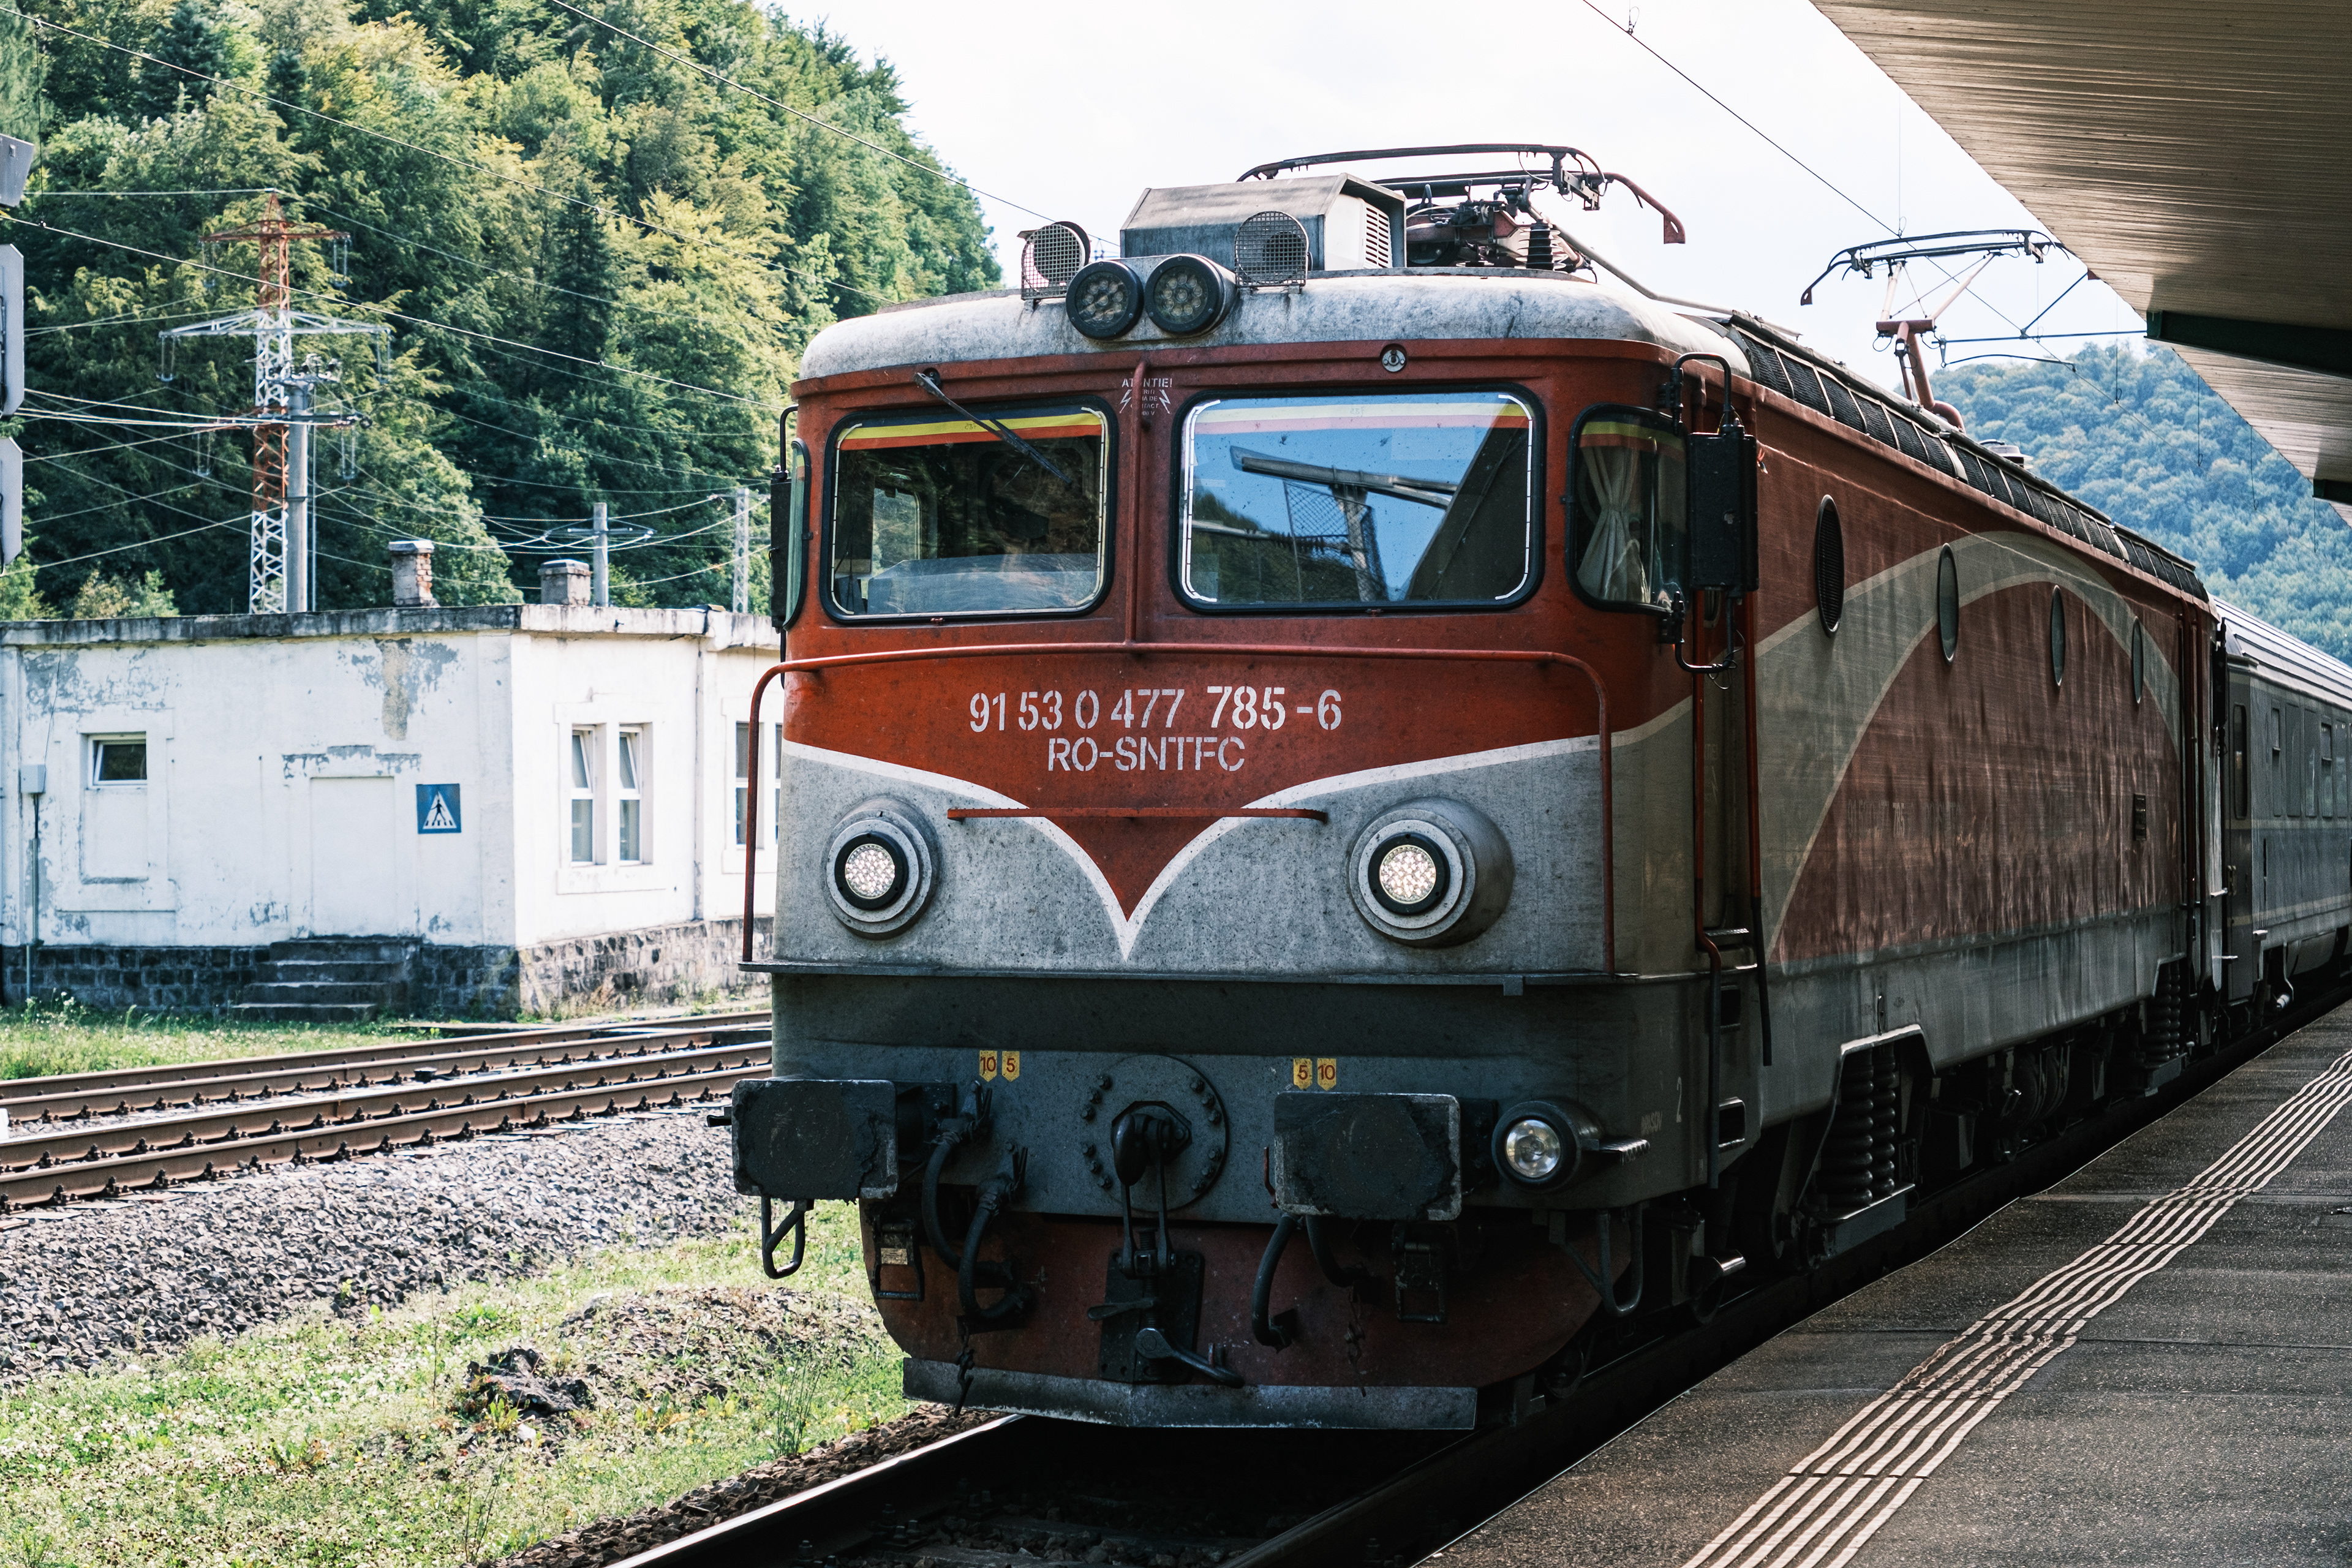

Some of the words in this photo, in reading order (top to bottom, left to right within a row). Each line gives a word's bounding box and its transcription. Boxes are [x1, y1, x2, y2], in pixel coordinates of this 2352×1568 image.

[1121, 378, 1172, 387] ATNTIE!
[970, 692, 1005, 731] 91
[1019, 690, 1063, 731] 53
[1075, 690, 1099, 729] 0
[1110, 689, 1185, 728] 477
[1048, 736, 1245, 772] RO-SNTFC
[981, 1057, 996, 1072] 10
[1006, 1058, 1016, 1073] 5
[1298, 1065, 1308, 1080] 5
[1317, 1065, 1335, 1080] 10
[1676, 1076, 1682, 1123] 2
